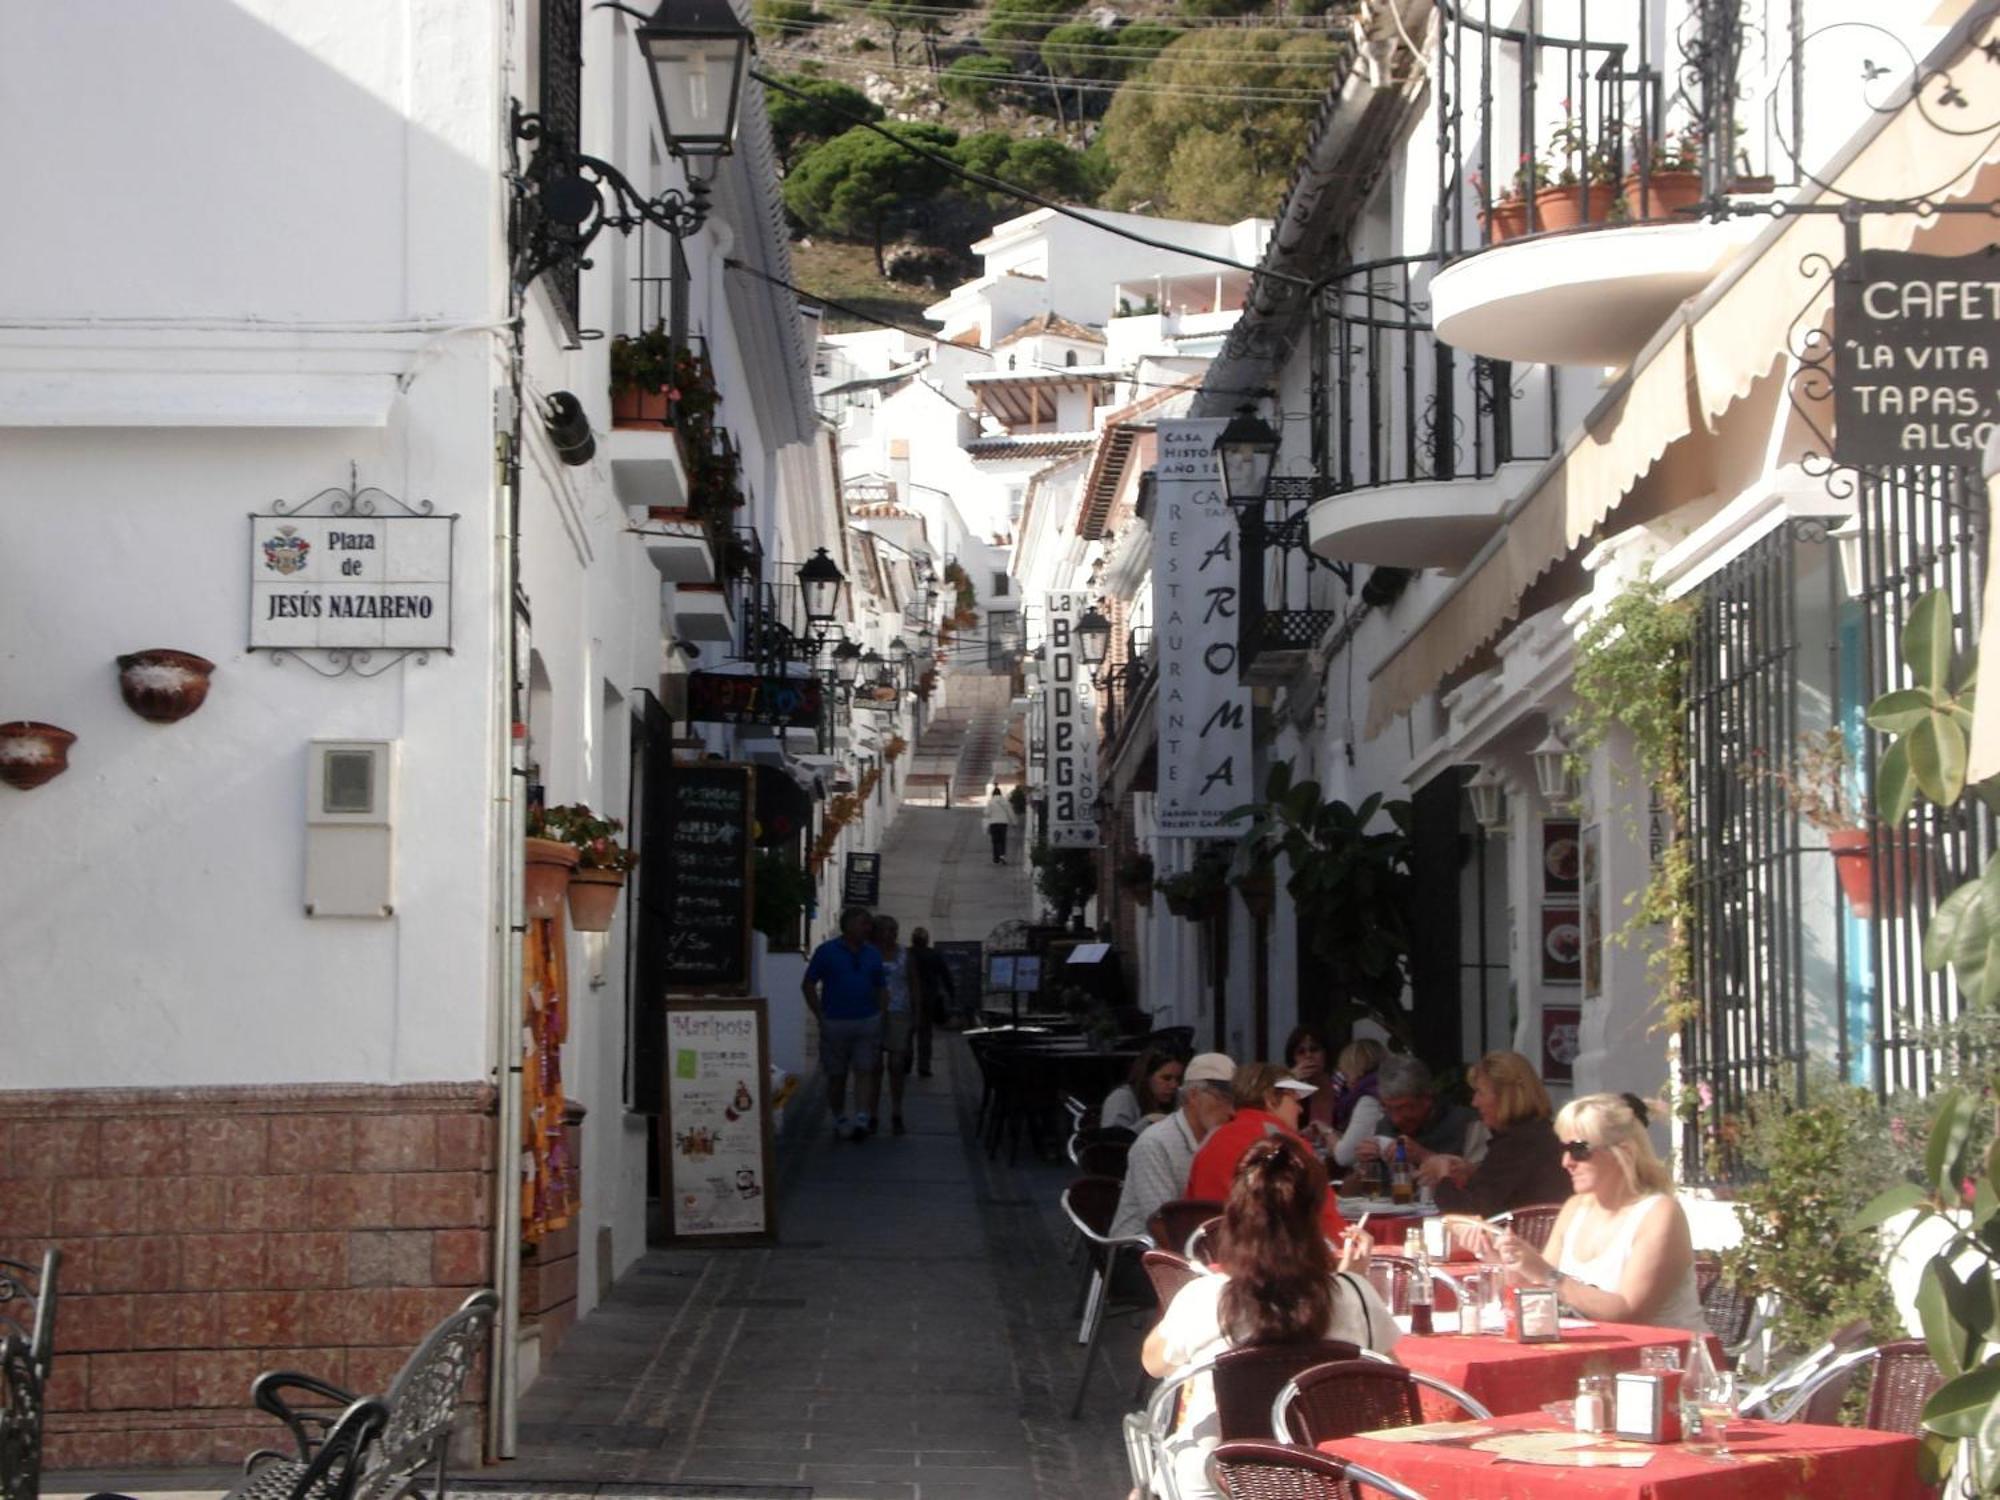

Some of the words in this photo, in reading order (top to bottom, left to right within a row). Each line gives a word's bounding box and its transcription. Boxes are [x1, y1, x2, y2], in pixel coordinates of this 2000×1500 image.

[1904, 346, 1989, 370] VITA
[1852, 385, 1991, 417] TAPAS,
[1164, 433, 1202, 443] CASA
[1163, 461, 1195, 473] AÑO
[328, 531, 375, 550] Plaza
[342, 558, 363, 576] de
[267, 590, 323, 620] JESÚS
[329, 595, 433, 619] NAZARENO
[1167, 504, 1184, 781] RESTAURANTE
[1200, 530, 1243, 797] AROMA
[1079, 742, 1093, 800] VINO
